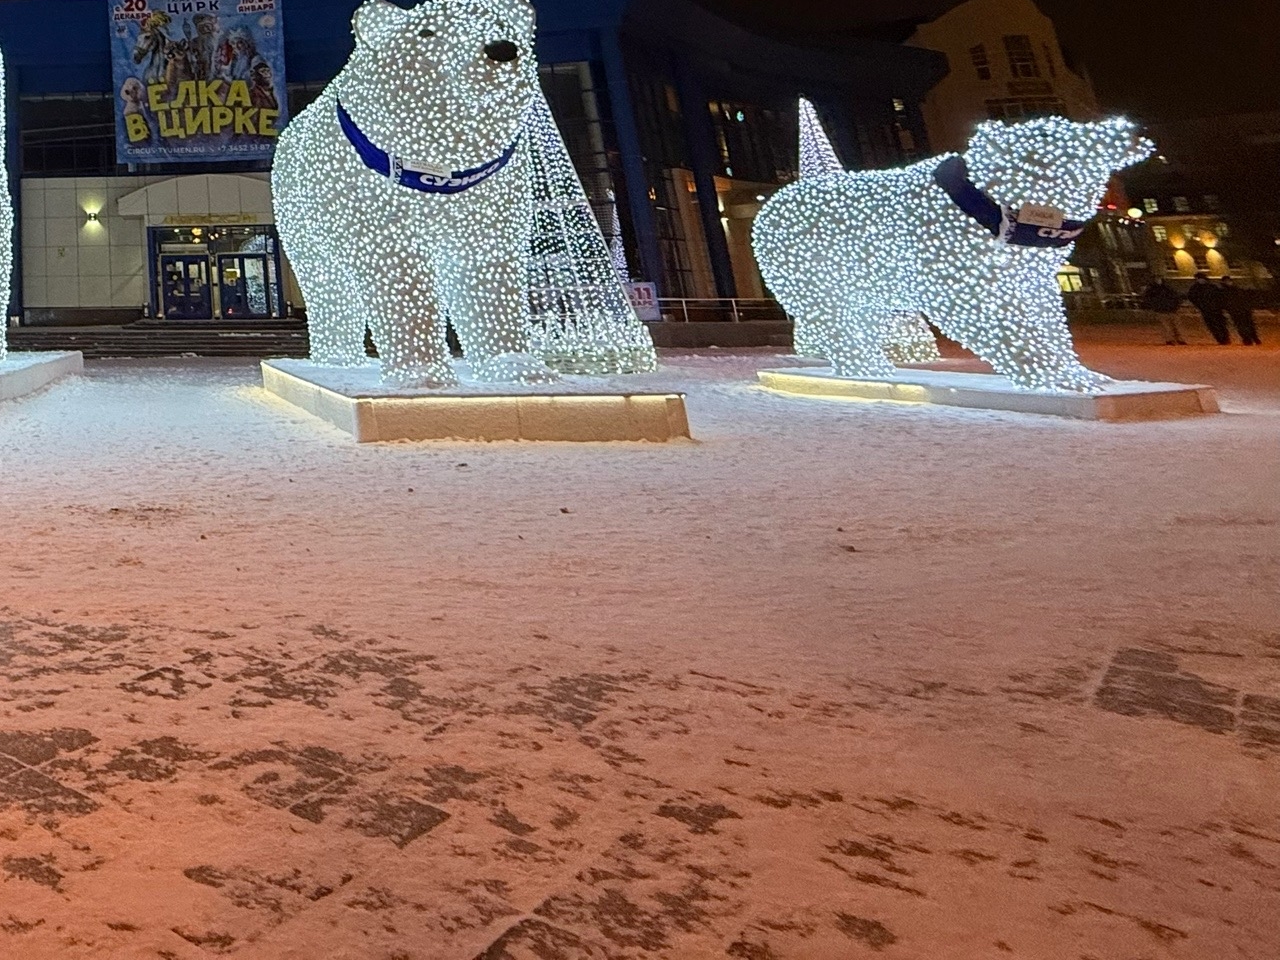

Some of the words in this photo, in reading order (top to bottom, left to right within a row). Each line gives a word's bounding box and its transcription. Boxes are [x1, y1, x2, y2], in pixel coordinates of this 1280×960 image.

[114, 12, 152, 21] ДЕКАБРЯ
[167, 0, 220, 14] ЦИРК
[238, 3, 274, 13] ЯНВАРЯ
[147, 77, 252, 112] ЁЛКА
[125, 114, 150, 143] В
[158, 106, 280, 139] ЦИРКЕ
[420, 162, 500, 187] СУЭНКО
